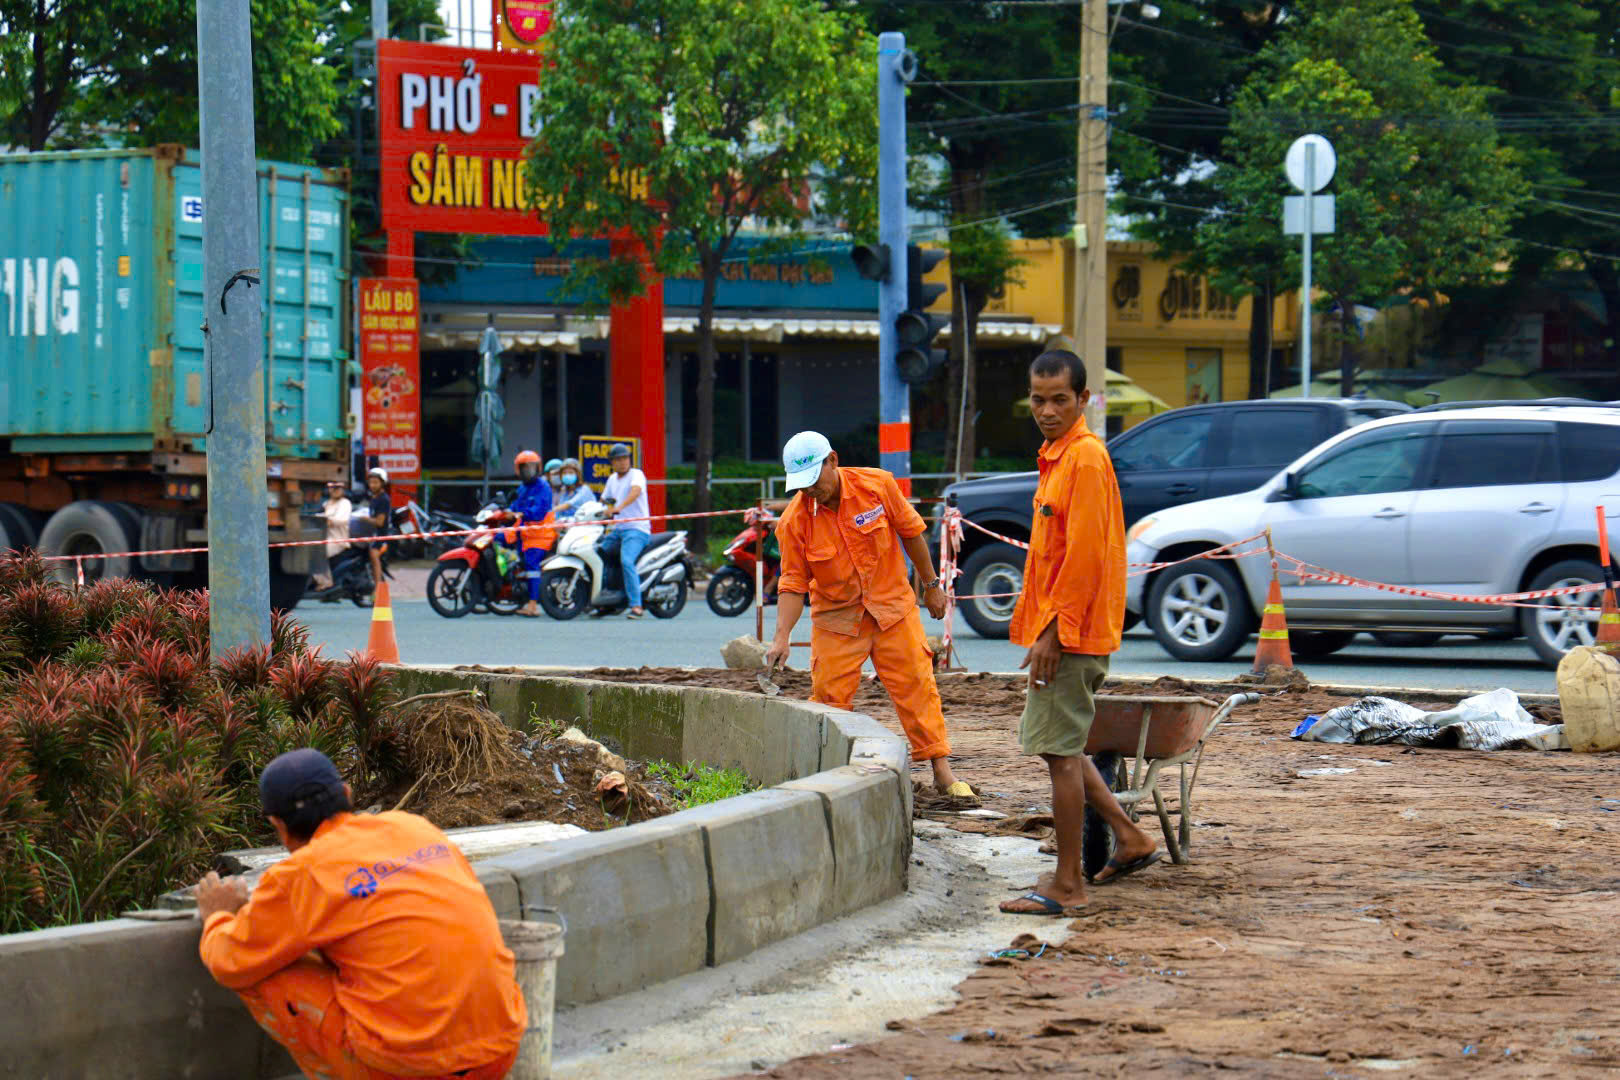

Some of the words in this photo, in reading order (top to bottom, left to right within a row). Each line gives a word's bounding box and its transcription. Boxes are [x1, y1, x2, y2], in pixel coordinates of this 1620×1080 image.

[402, 58, 482, 133] PHỞ
[409, 143, 482, 208] SÂM
[0, 257, 80, 336] ING
